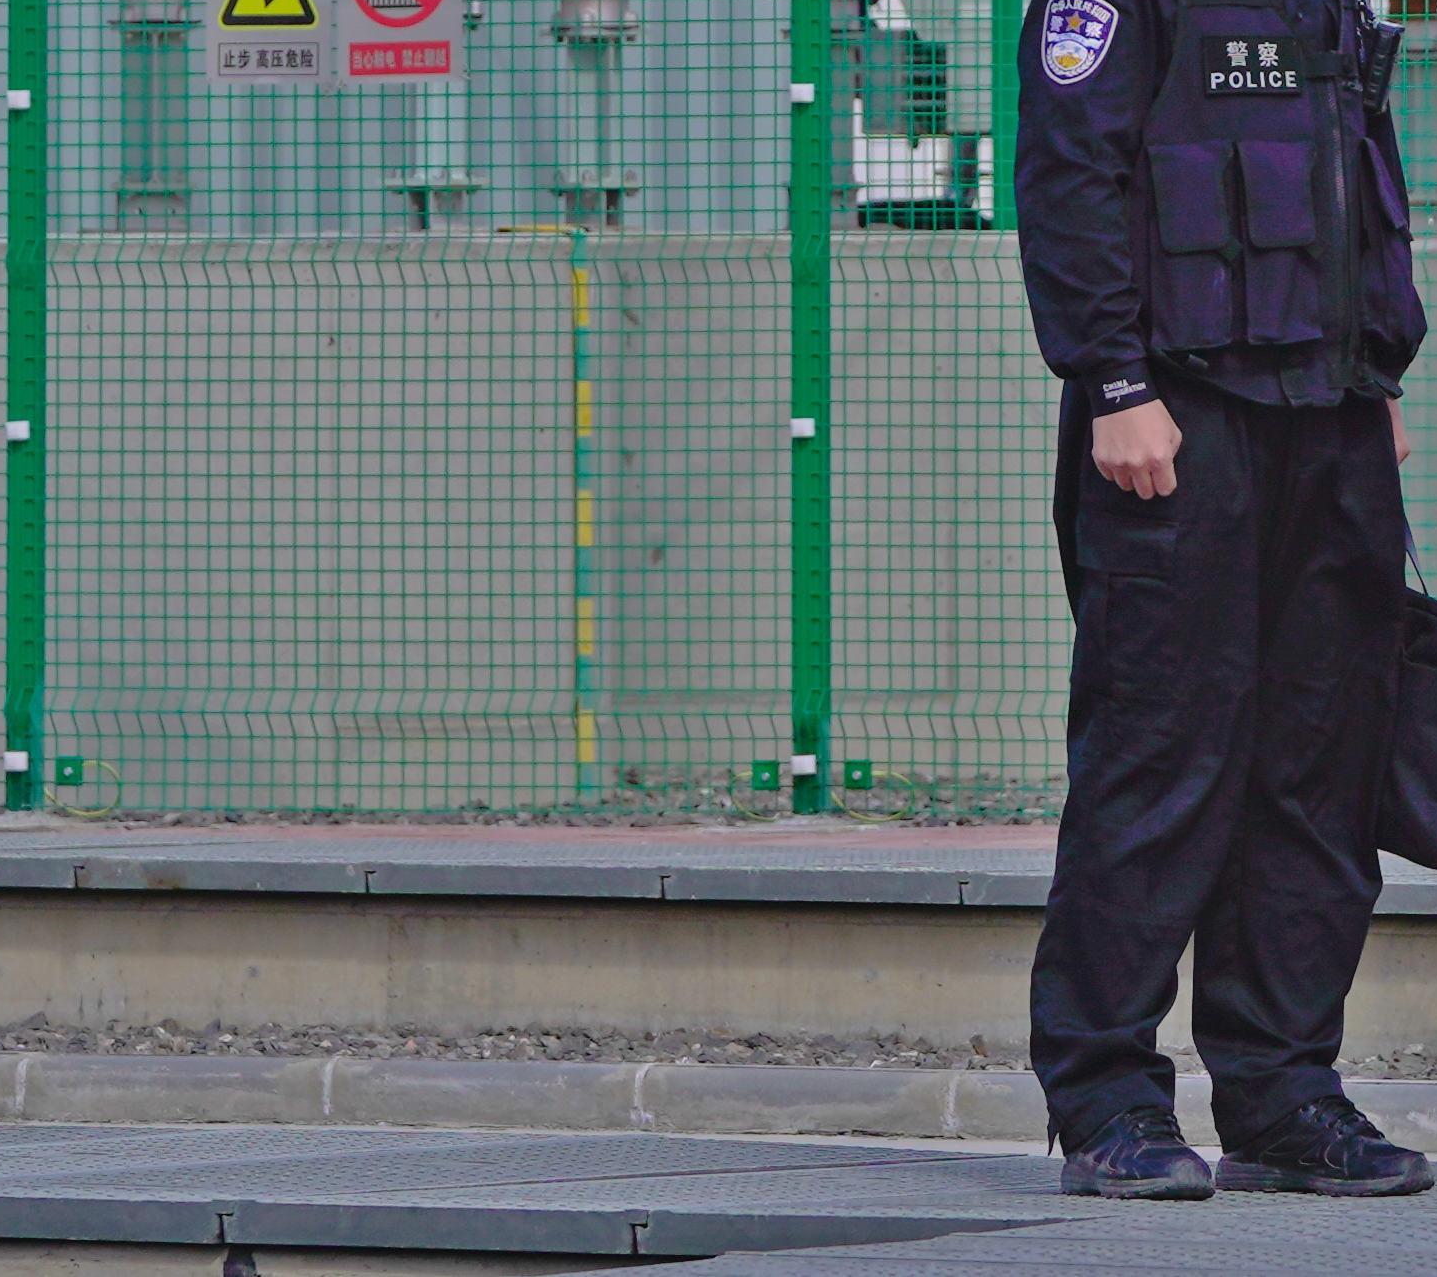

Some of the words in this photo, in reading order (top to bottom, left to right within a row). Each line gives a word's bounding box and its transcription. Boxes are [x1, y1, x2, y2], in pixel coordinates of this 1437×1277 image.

[223, 49, 251, 68] 止步
[256, 48, 314, 68] 高压危险
[1226, 40, 1279, 67] 警察
[1210, 70, 1298, 89] POLICE
